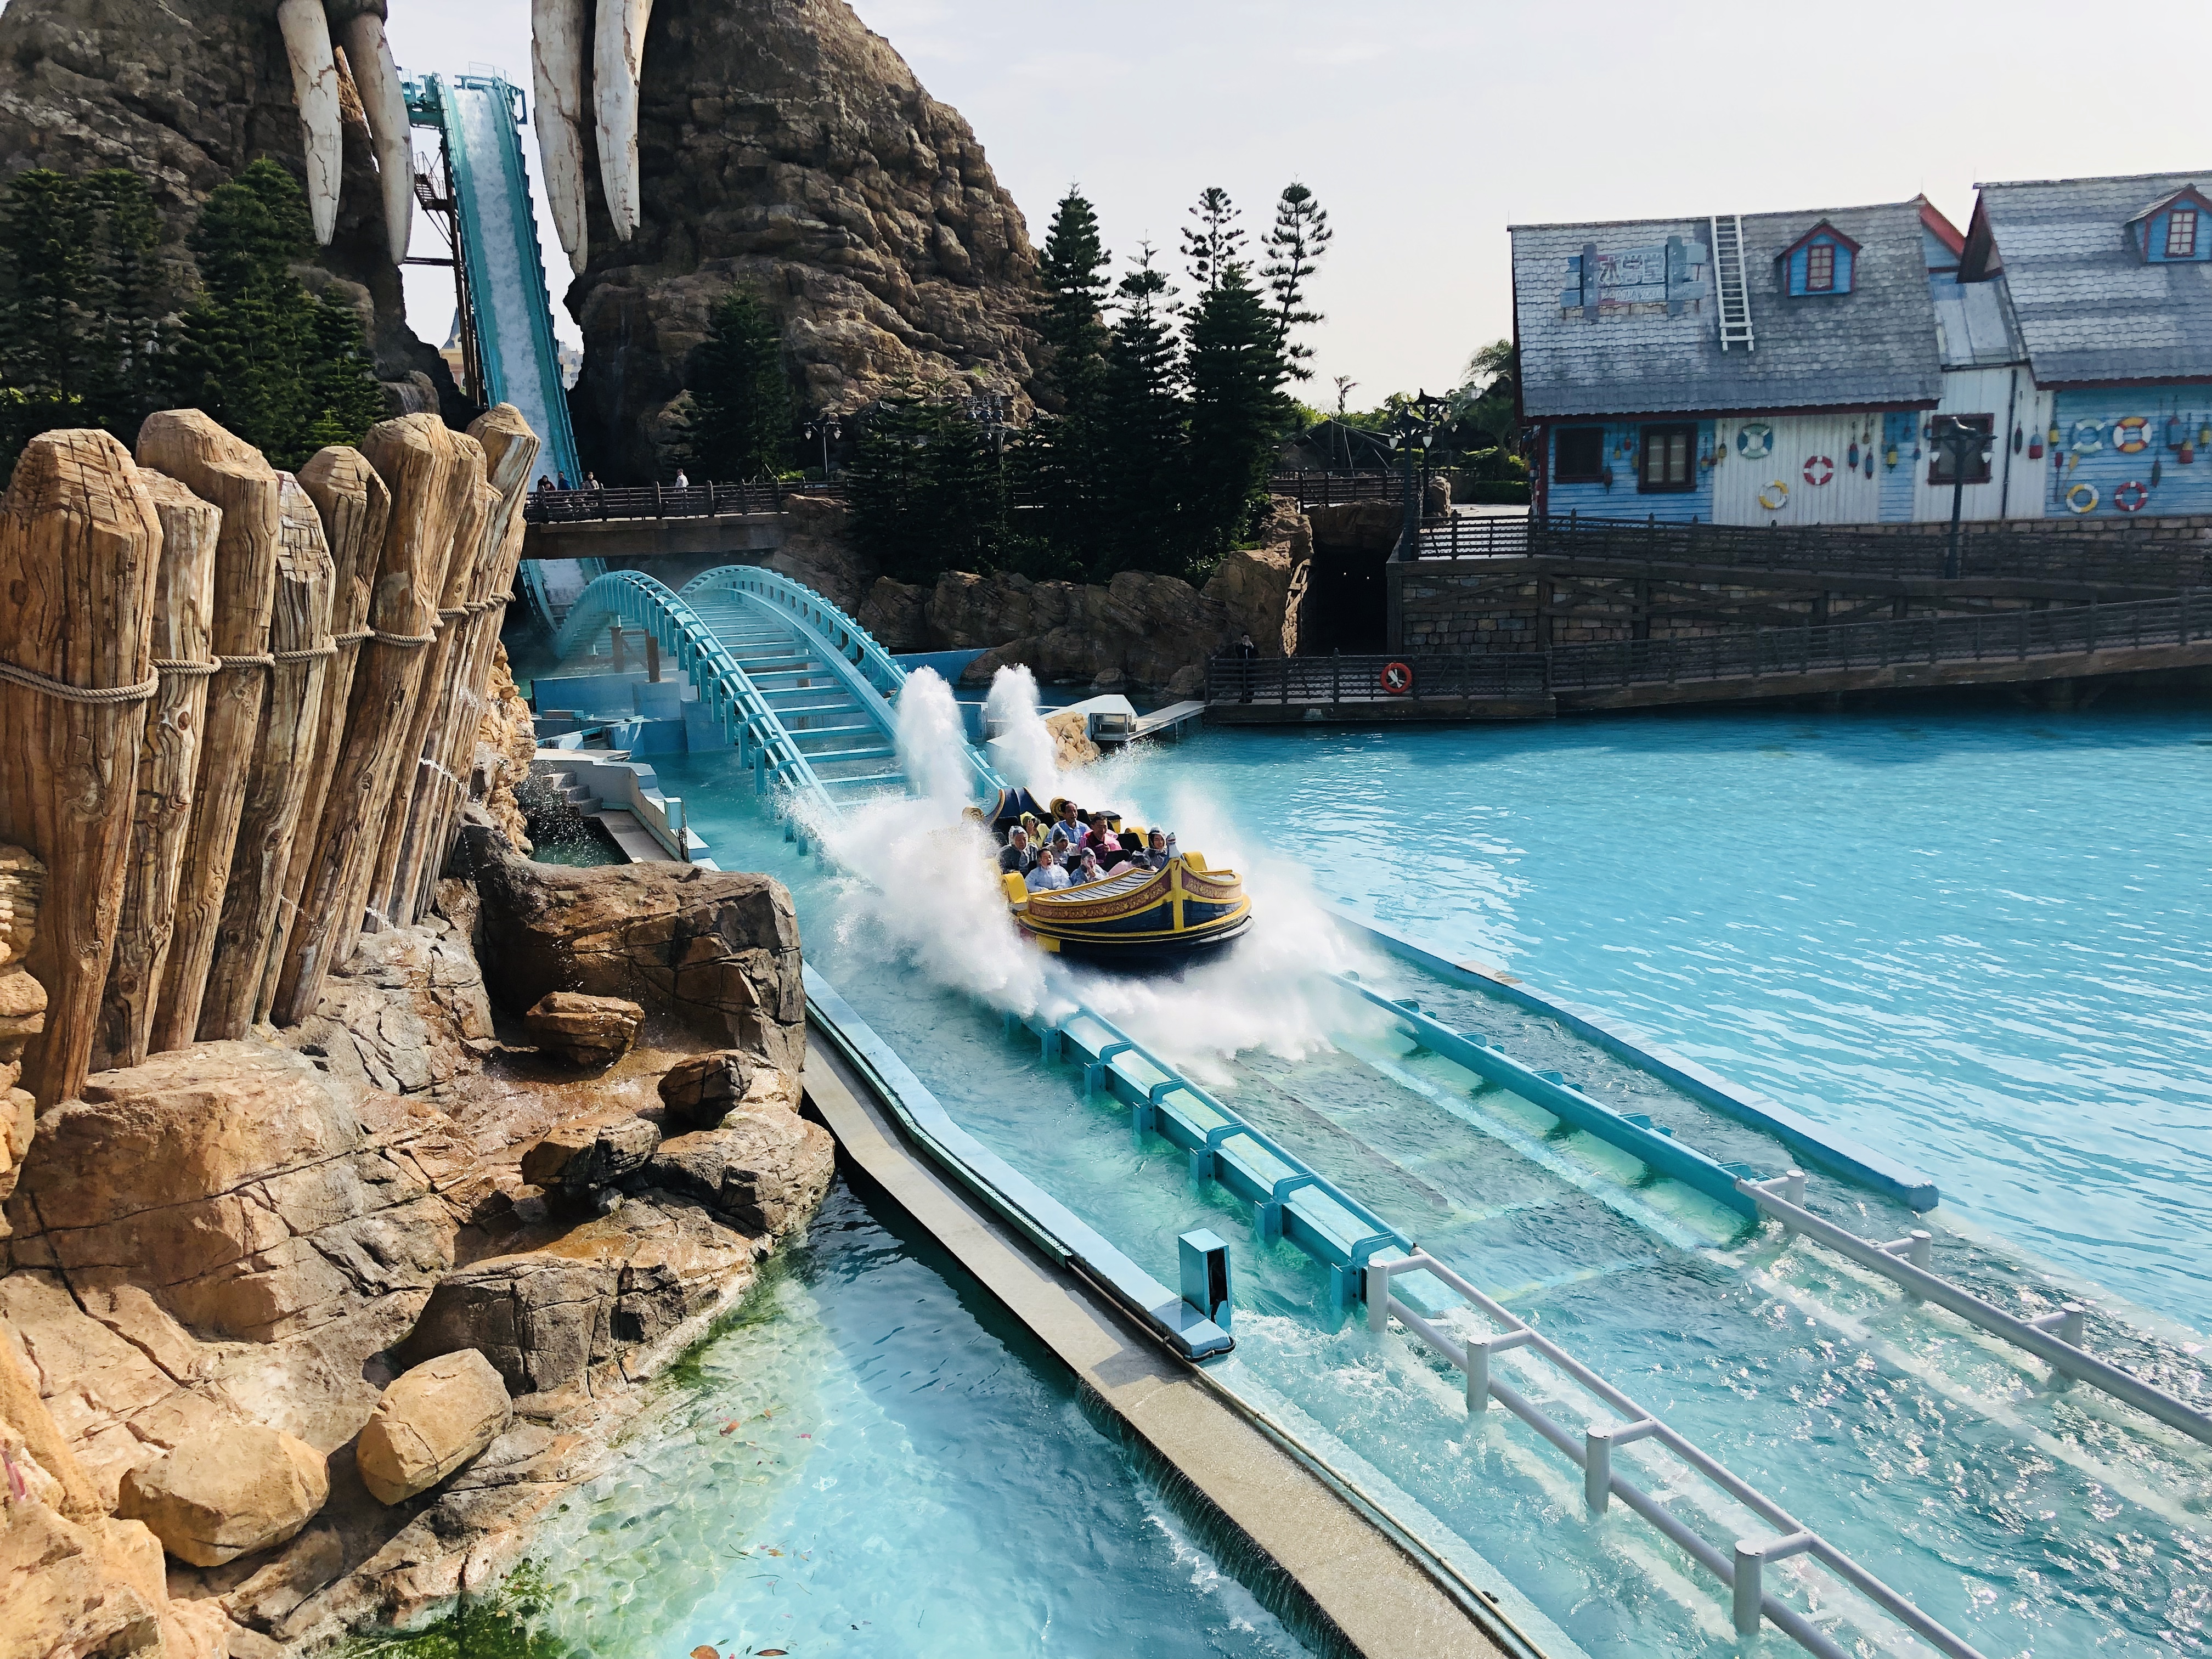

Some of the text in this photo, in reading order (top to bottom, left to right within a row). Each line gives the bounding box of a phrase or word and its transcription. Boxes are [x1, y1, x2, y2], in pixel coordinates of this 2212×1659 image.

[1615, 287, 1665, 301] AQUA SCHOOL
[1173, 860, 1180, 870] 7
